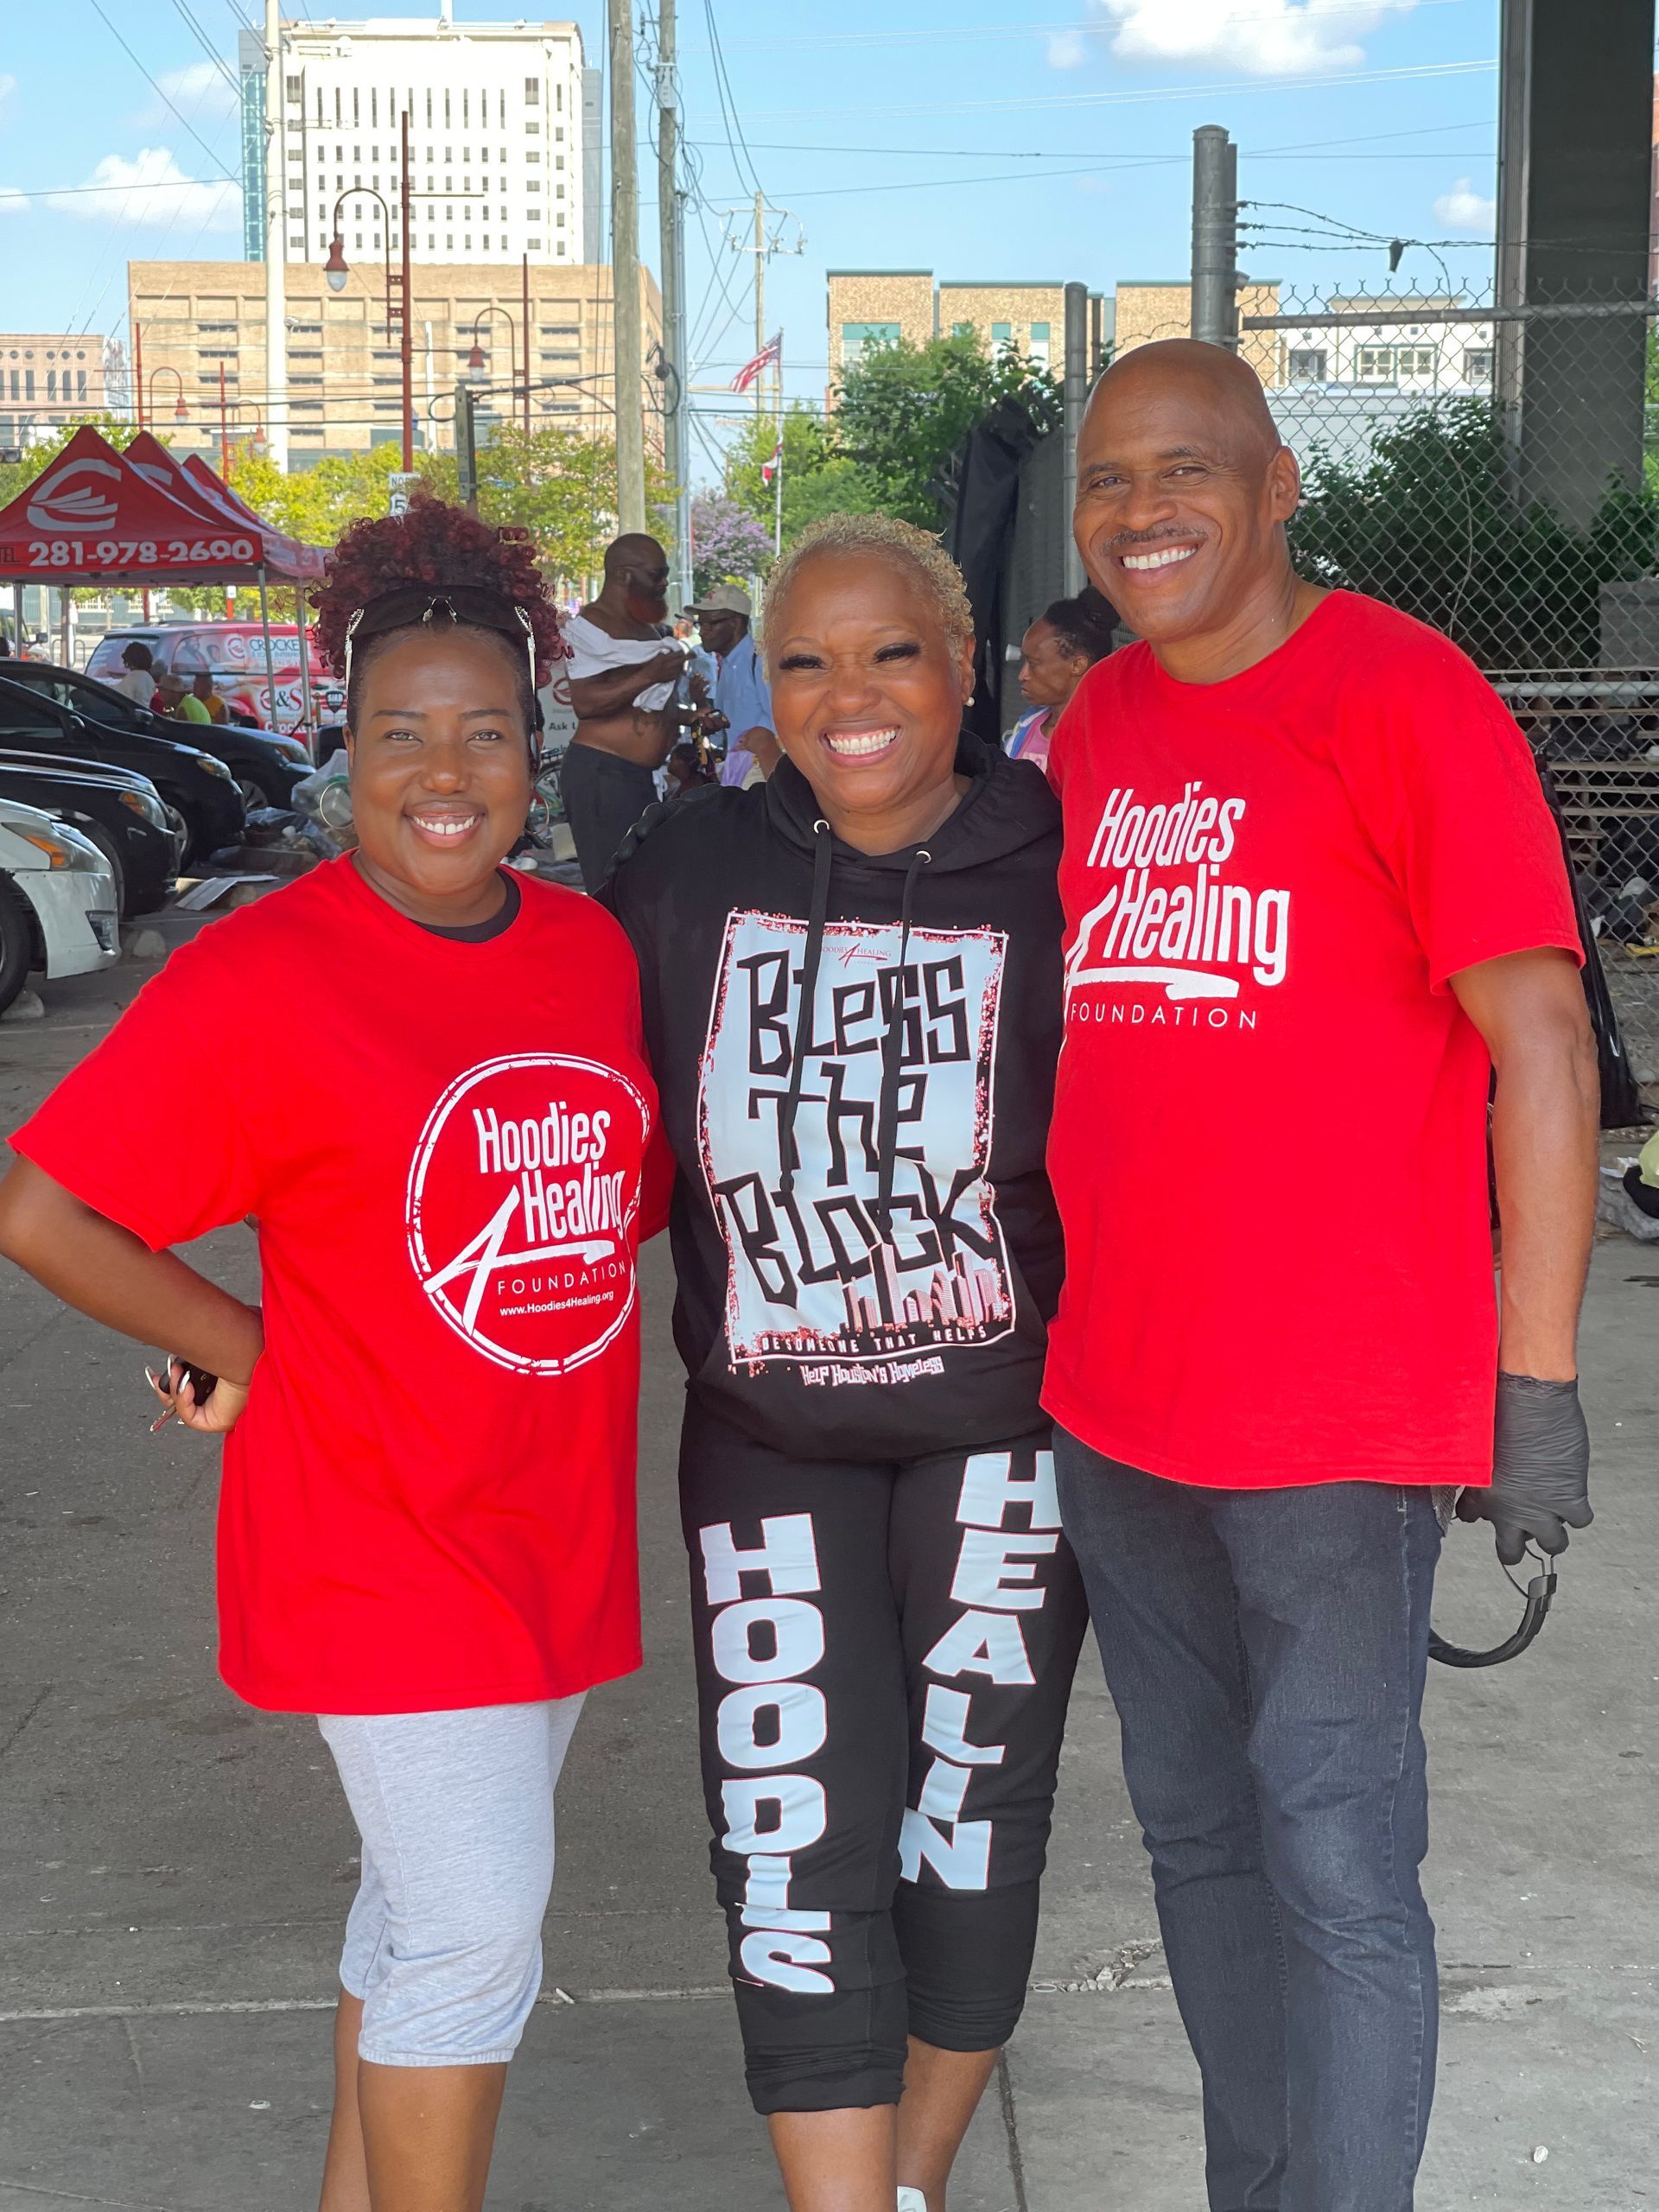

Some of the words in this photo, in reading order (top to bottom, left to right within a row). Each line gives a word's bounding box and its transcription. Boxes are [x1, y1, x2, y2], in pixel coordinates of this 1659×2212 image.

[29, 539, 254, 567] 281-978-2690
[250, 639, 301, 651] CROCKE
[549, 722, 568, 731] Ask
[1086, 781, 1246, 868] Hoodies
[1103, 863, 1291, 986] Healing
[856, 948, 892, 957] HEALING
[1071, 1002, 1256, 1029] FOUNDATION
[473, 1101, 611, 1174] Hoodies
[423, 1185, 615, 1337] 4
[521, 1162, 626, 1243] Healing
[498, 1261, 626, 1295] FOUNDATION
[499, 1290, 614, 1317] www.Hoodies4Healing.org
[874, 1333, 918, 1351] THAT
[932, 1325, 988, 1342] HELPS
